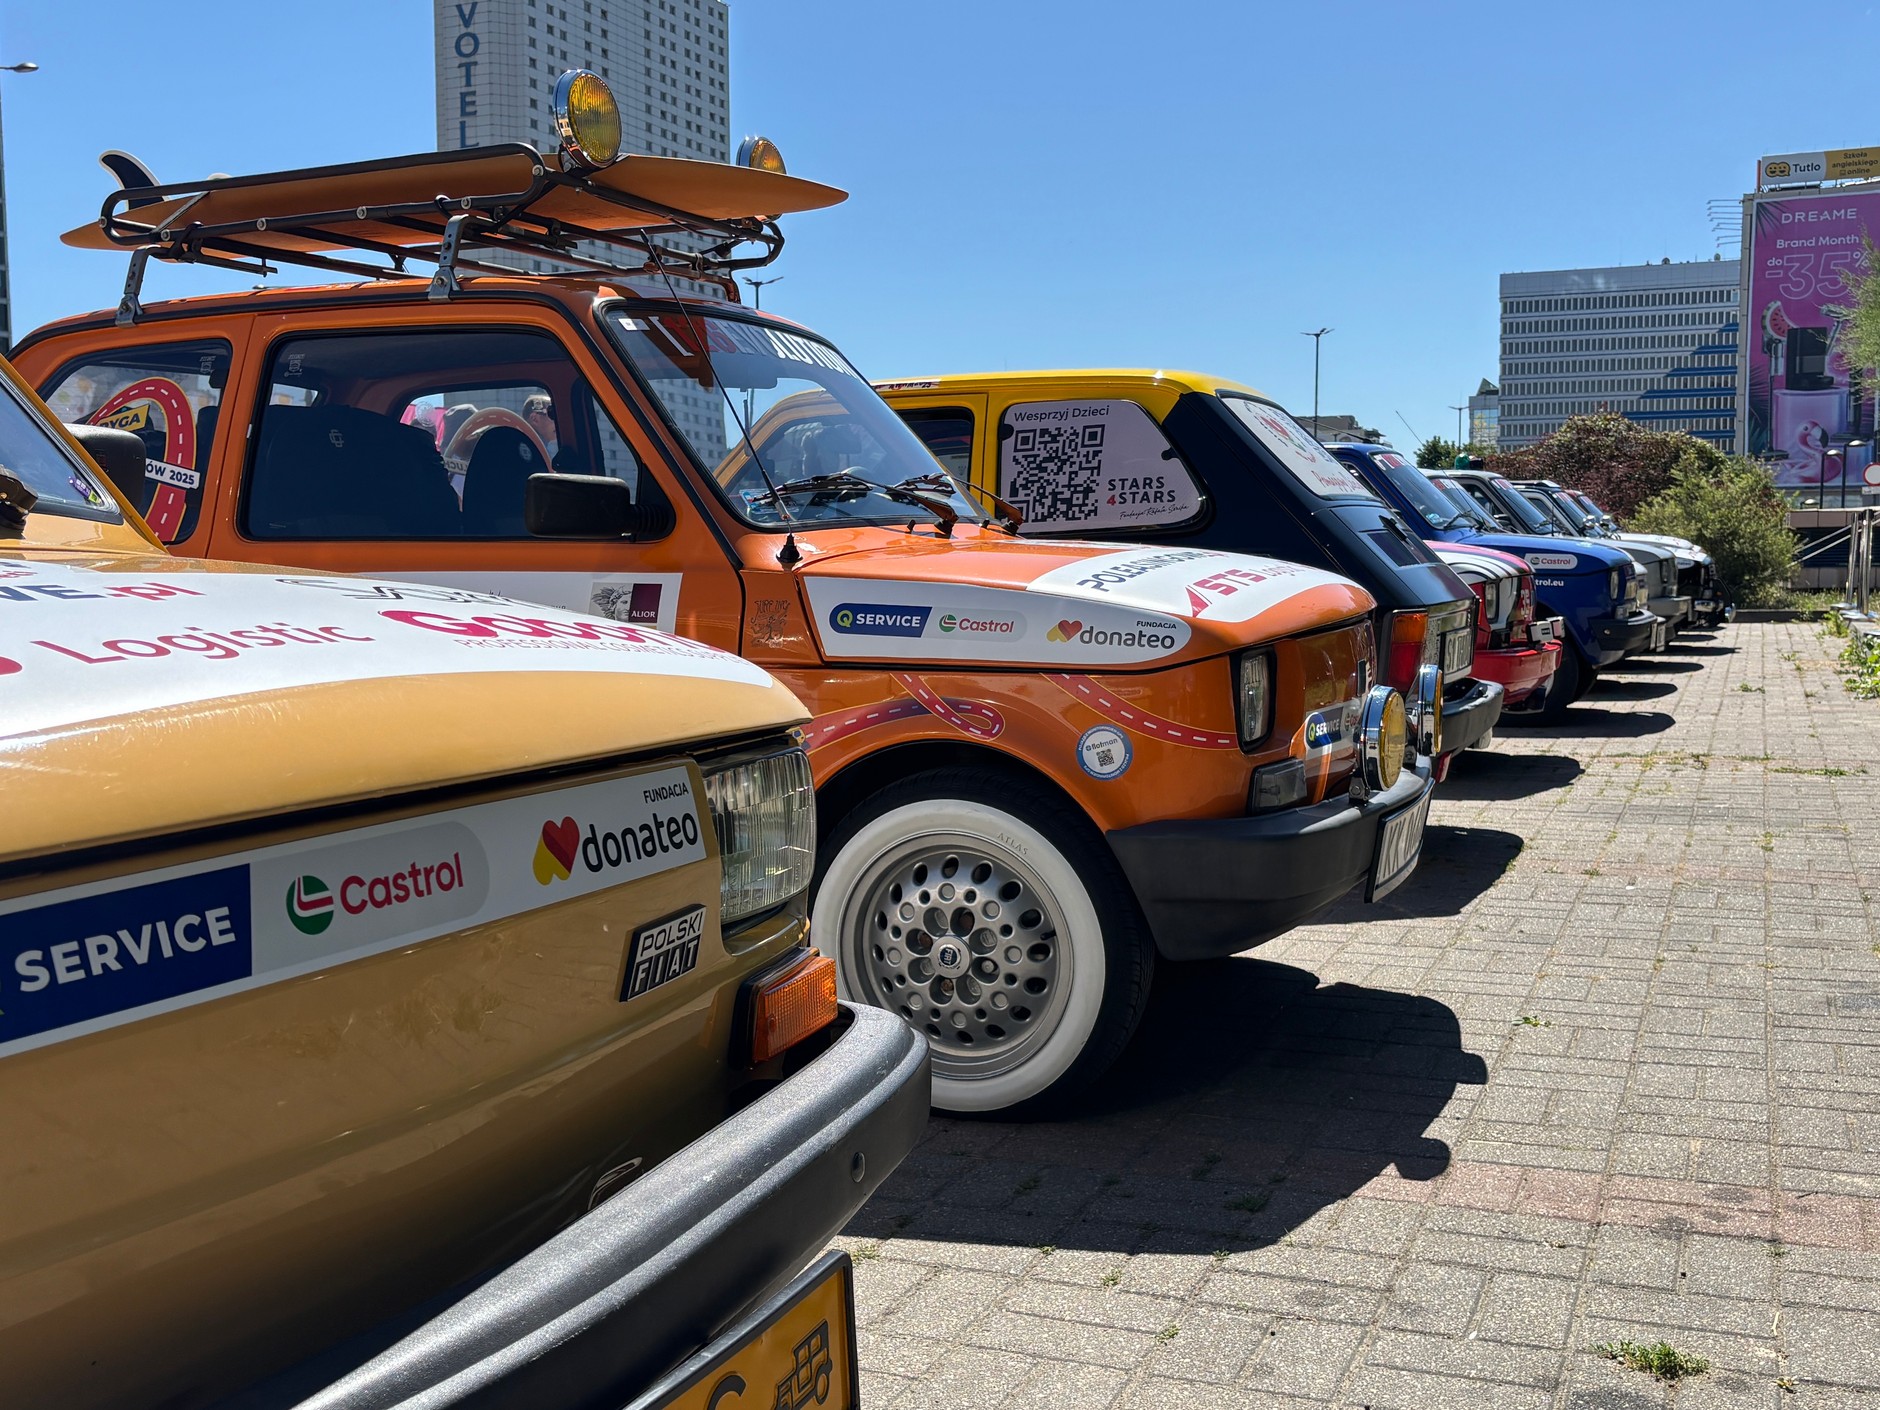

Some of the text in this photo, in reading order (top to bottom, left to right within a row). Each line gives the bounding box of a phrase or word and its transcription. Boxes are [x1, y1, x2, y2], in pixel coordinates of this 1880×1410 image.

[455, 1, 480, 149] VOTEL
[1843, 151, 1867, 159] Szkoła
[1792, 163, 1821, 174] Tutlo
[1832, 159, 1879, 169] angielskiego
[1847, 167, 1871, 175] online
[1781, 208, 1857, 224] DREAME
[1776, 235, 1860, 249] Brand Month
[1767, 257, 1783, 267] do
[1014, 405, 1110, 422] Wesprzyj Dzieci
[169, 469, 195, 485] 2025
[1108, 476, 1165, 491] STARS
[1193, 568, 1268, 596] STS
[1535, 578, 1565, 587] trol.eu
[631, 610, 656, 618] ALIOR
[855, 612, 922, 628] SERVICE
[957, 616, 1015, 635] Castrol
[1136, 620, 1177, 630] FUNDACJA
[30, 622, 376, 664] Logistic
[1079, 624, 1175, 650] donateo
[643, 782, 689, 804] FUNDACJA
[581, 812, 699, 873] donateo
[997, 832, 1029, 855] ATLAS
[340, 852, 464, 915] Castrol
[640, 911, 703, 958] POLSKI
[14, 906, 236, 992] SERVICE
[632, 939, 699, 995] FIAT
